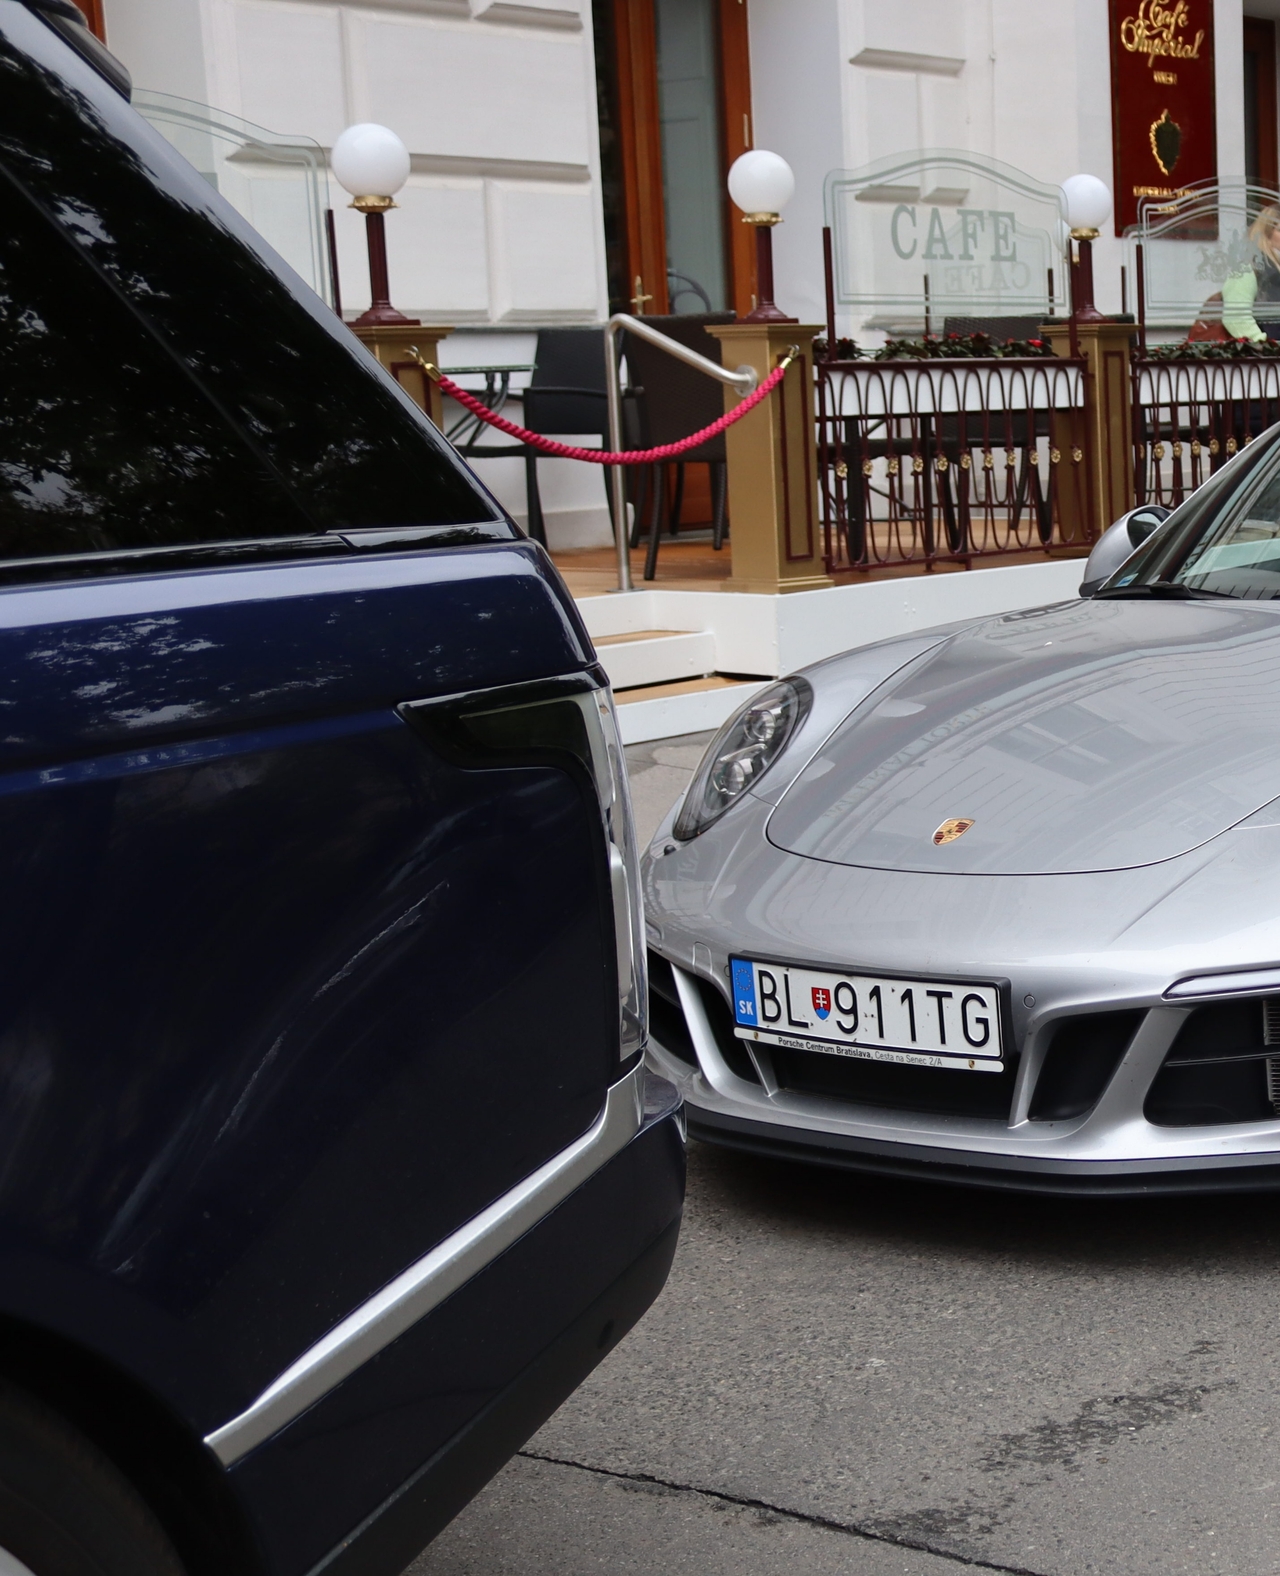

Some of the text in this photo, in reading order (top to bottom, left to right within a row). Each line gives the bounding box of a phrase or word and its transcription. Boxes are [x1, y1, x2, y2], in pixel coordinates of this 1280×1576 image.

[1139, 0, 1190, 39] Café
[1121, 17, 1205, 68] Imperial
[890, 203, 1019, 263] CAFE
[738, 999, 754, 1016] SK
[757, 969, 991, 1048] BL 911TG
[778, 1036, 943, 1067] Porsche Centrum Bratislava, Cesta na Senec 2/A
